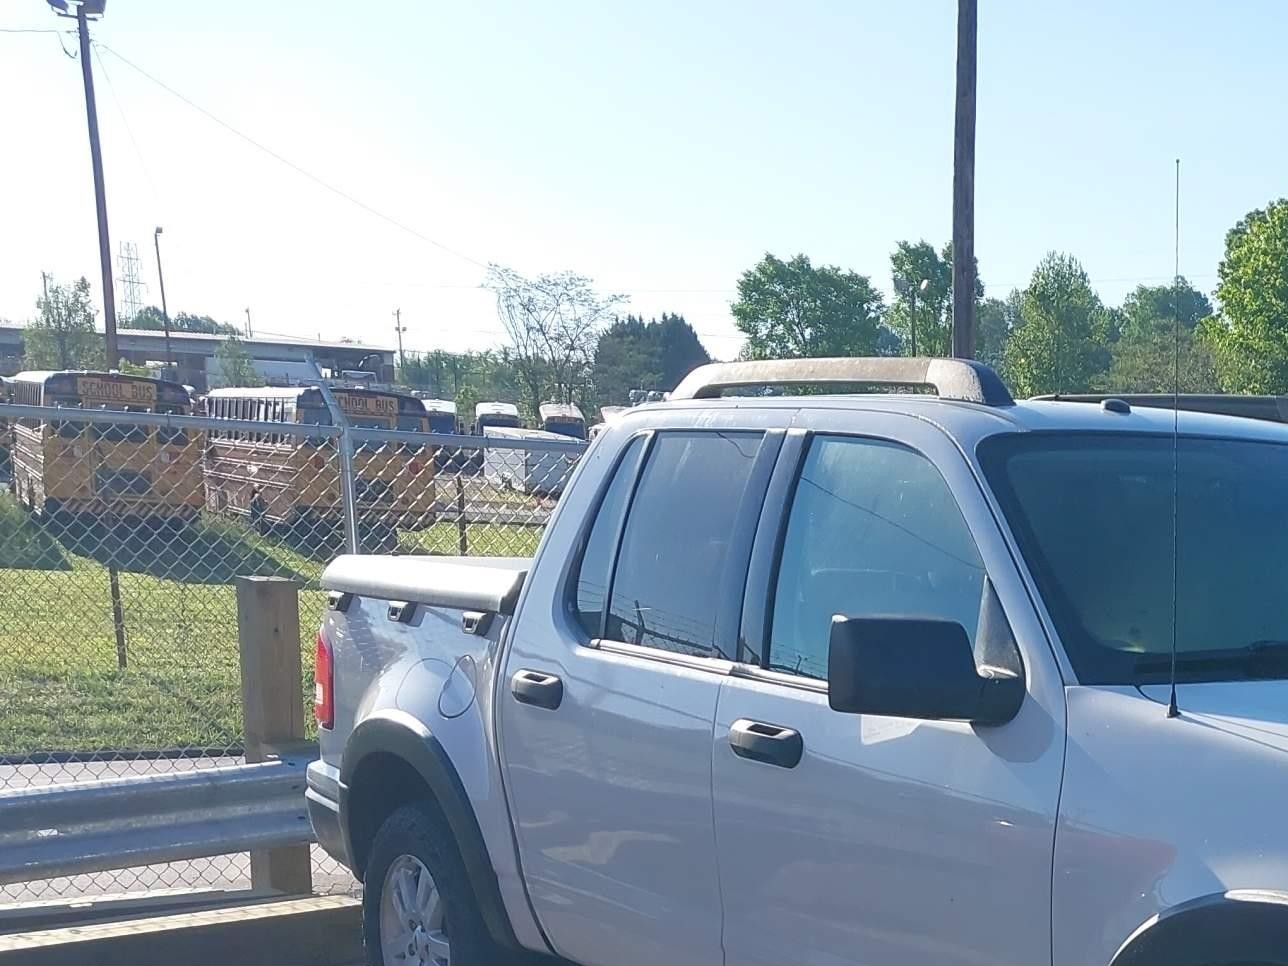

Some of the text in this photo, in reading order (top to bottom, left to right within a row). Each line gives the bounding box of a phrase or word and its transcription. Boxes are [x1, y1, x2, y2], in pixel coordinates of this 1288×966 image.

[81, 381, 153, 400] SCHOOL BUS
[375, 399, 395, 411] BUS
